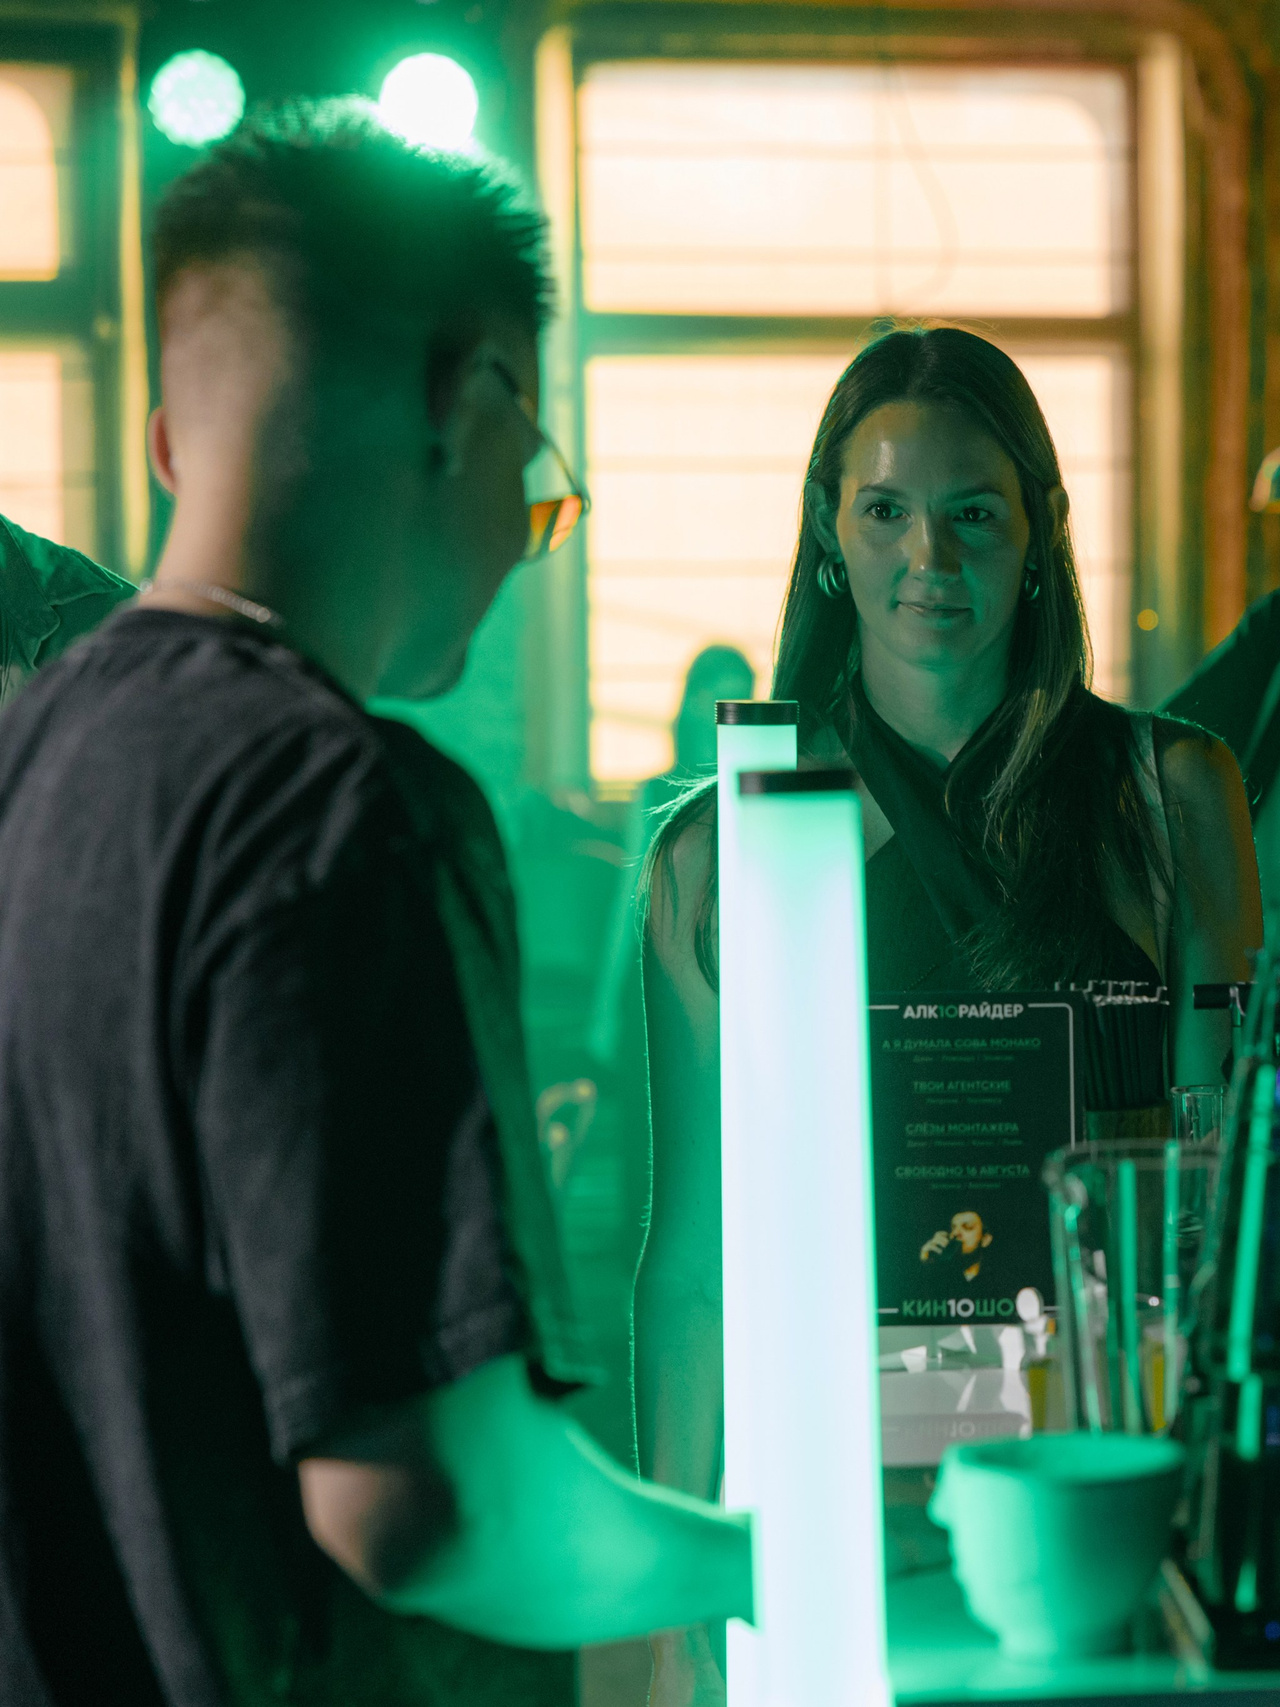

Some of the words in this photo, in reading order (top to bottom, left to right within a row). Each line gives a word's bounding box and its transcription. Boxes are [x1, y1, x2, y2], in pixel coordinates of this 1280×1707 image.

[904, 1038, 951, 1050] ДУМАЛА
[954, 1038, 987, 1048] СОВА
[990, 1037, 1041, 1048] МОНАКО
[947, 1080, 1011, 1091] АГЕНТСКИЕ
[895, 1166, 963, 1177] СВОБОДНО
[980, 1164, 1030, 1176] АВГУСТА
[902, 1298, 1016, 1318] КИН10ШО
